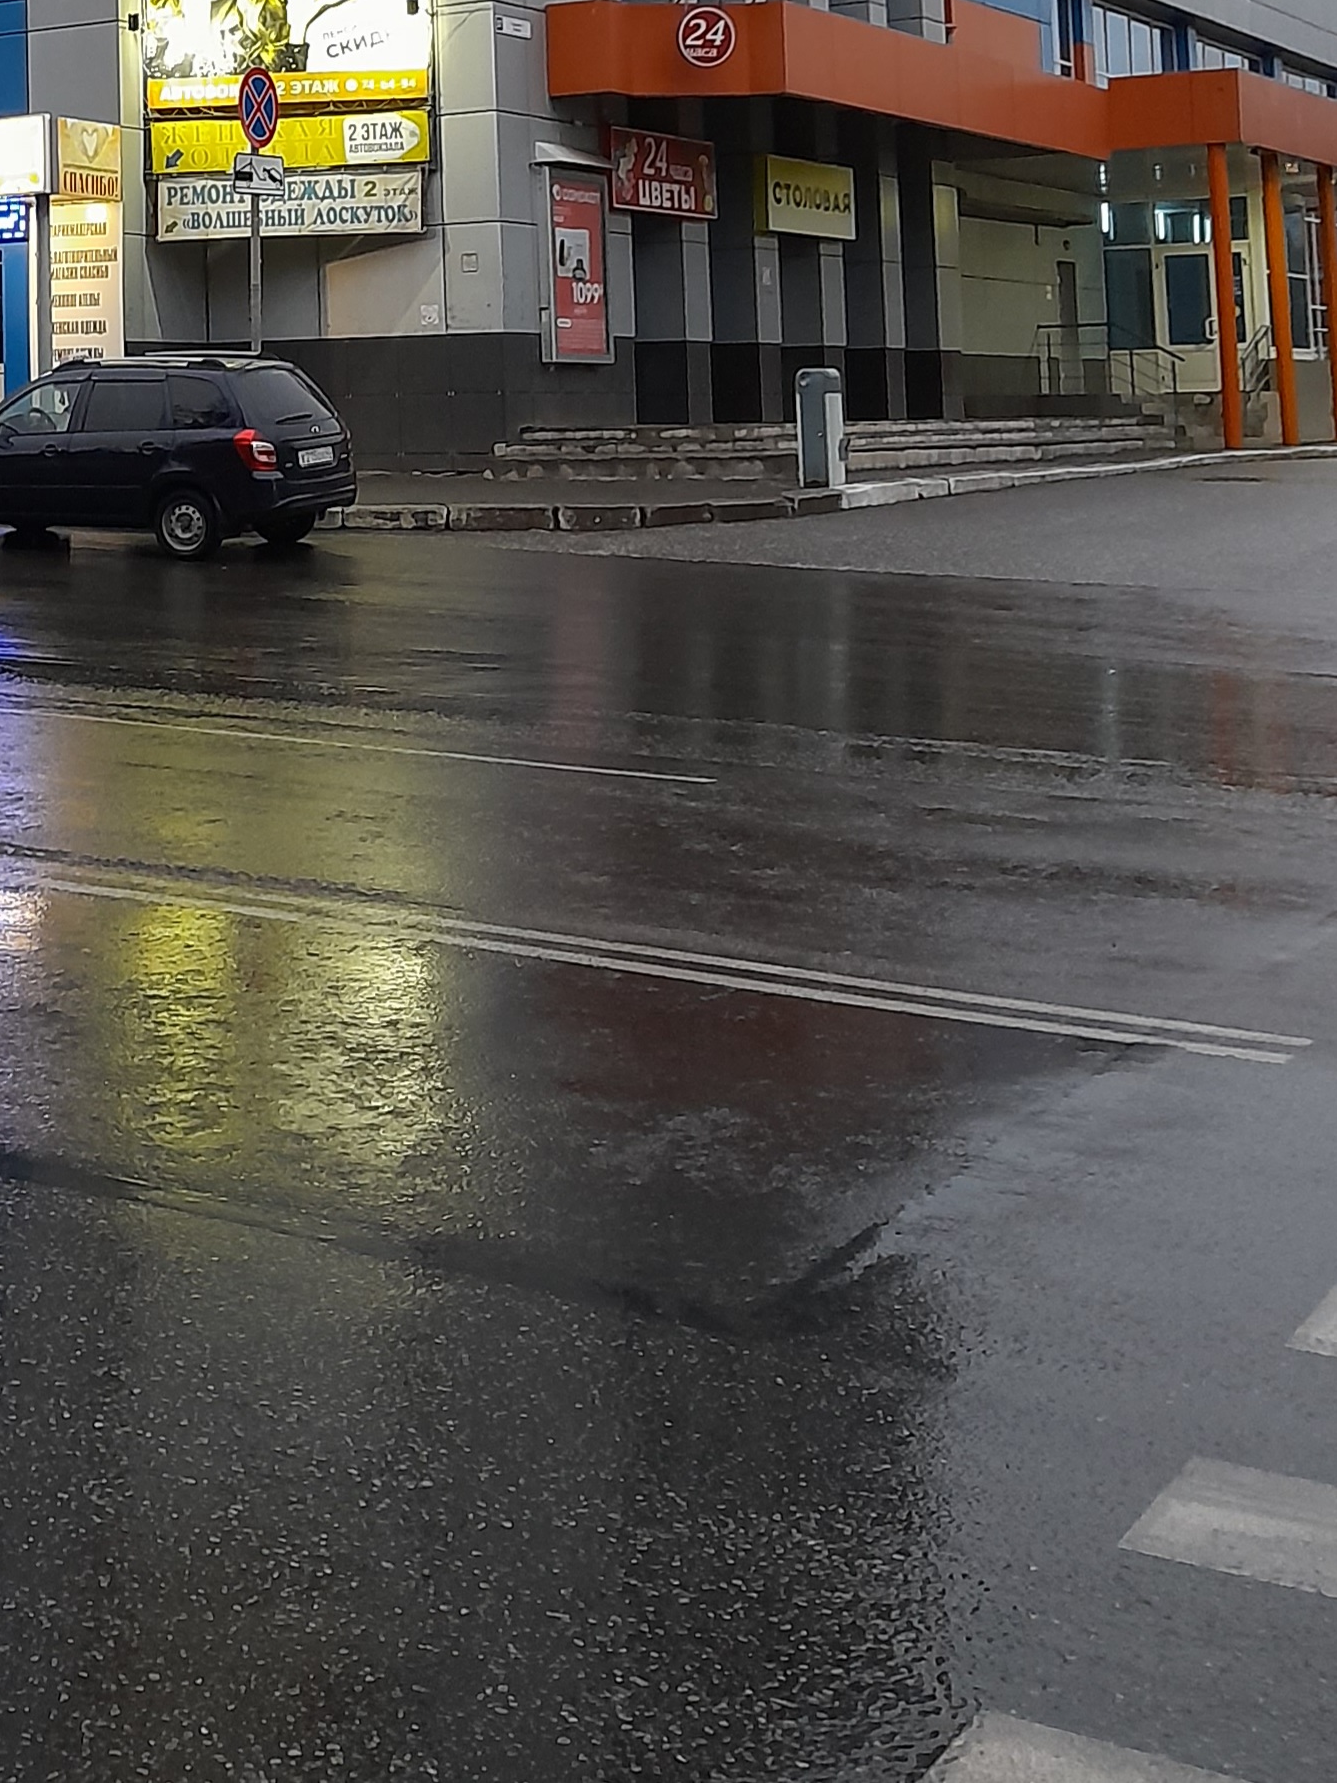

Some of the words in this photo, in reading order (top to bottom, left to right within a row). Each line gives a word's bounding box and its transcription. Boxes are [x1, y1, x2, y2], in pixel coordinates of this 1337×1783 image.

[684, 18, 727, 46] 24
[289, 78, 340, 95] ЭТАЖ
[348, 123, 357, 142] 2
[361, 120, 404, 141] ЭТАЖ
[348, 140, 405, 154] АВТОВОКЗАЛА
[643, 137, 668, 177] 24
[63, 170, 119, 198] СПАСИБО!
[363, 180, 377, 197] 2
[637, 178, 696, 211] ЦВЕТЫ
[772, 181, 852, 214] СТОЛОВАЯ
[182, 203, 305, 230] «ВОЛШЕНЫЙ
[572, 281, 600, 305] 1099
